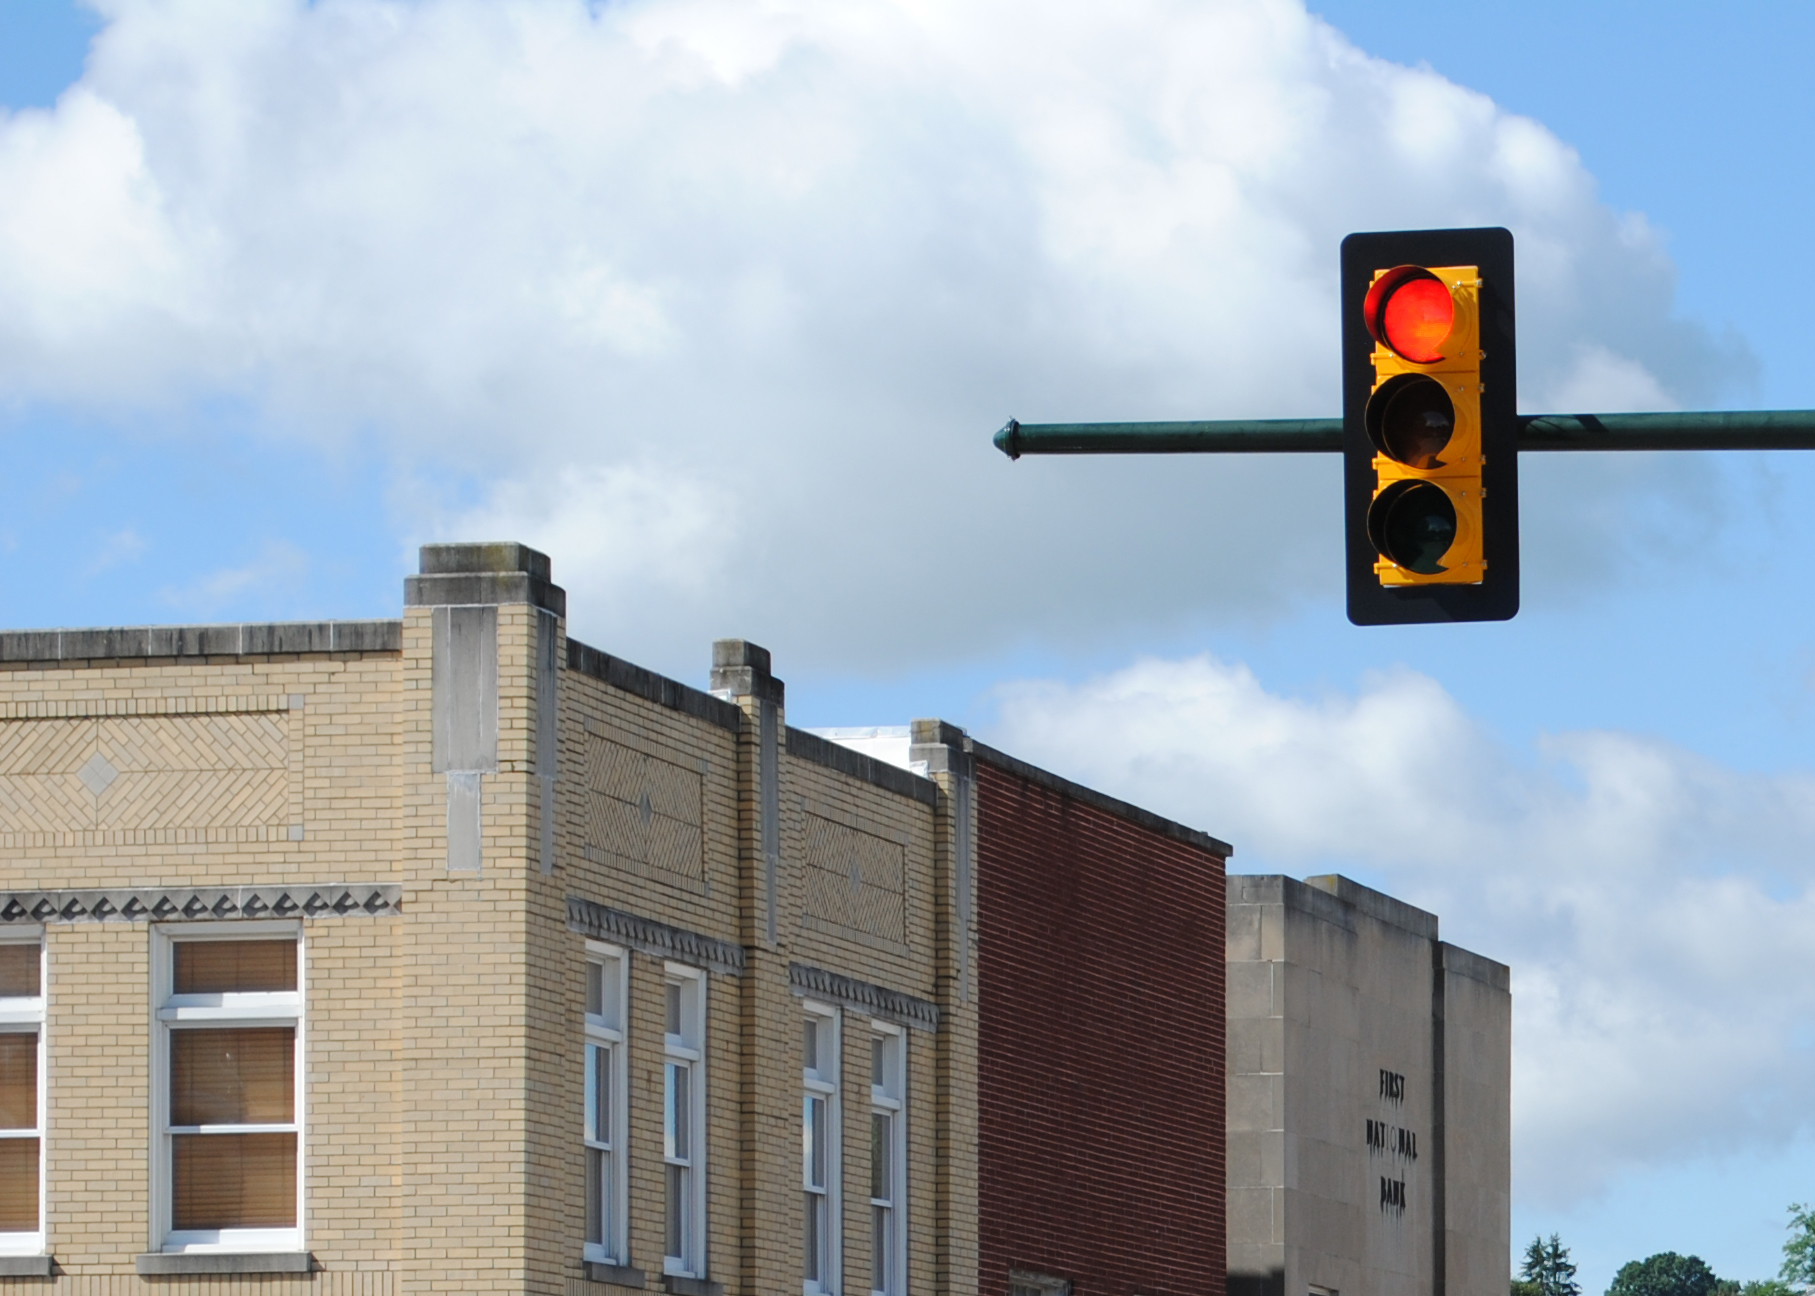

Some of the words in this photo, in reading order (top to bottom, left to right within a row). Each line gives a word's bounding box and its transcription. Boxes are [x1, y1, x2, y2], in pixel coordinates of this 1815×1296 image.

[1379, 1068, 1405, 1101] FIRST
[1366, 1118, 1418, 1160] NATIONAL
[1380, 1175, 1406, 1208] BANK
